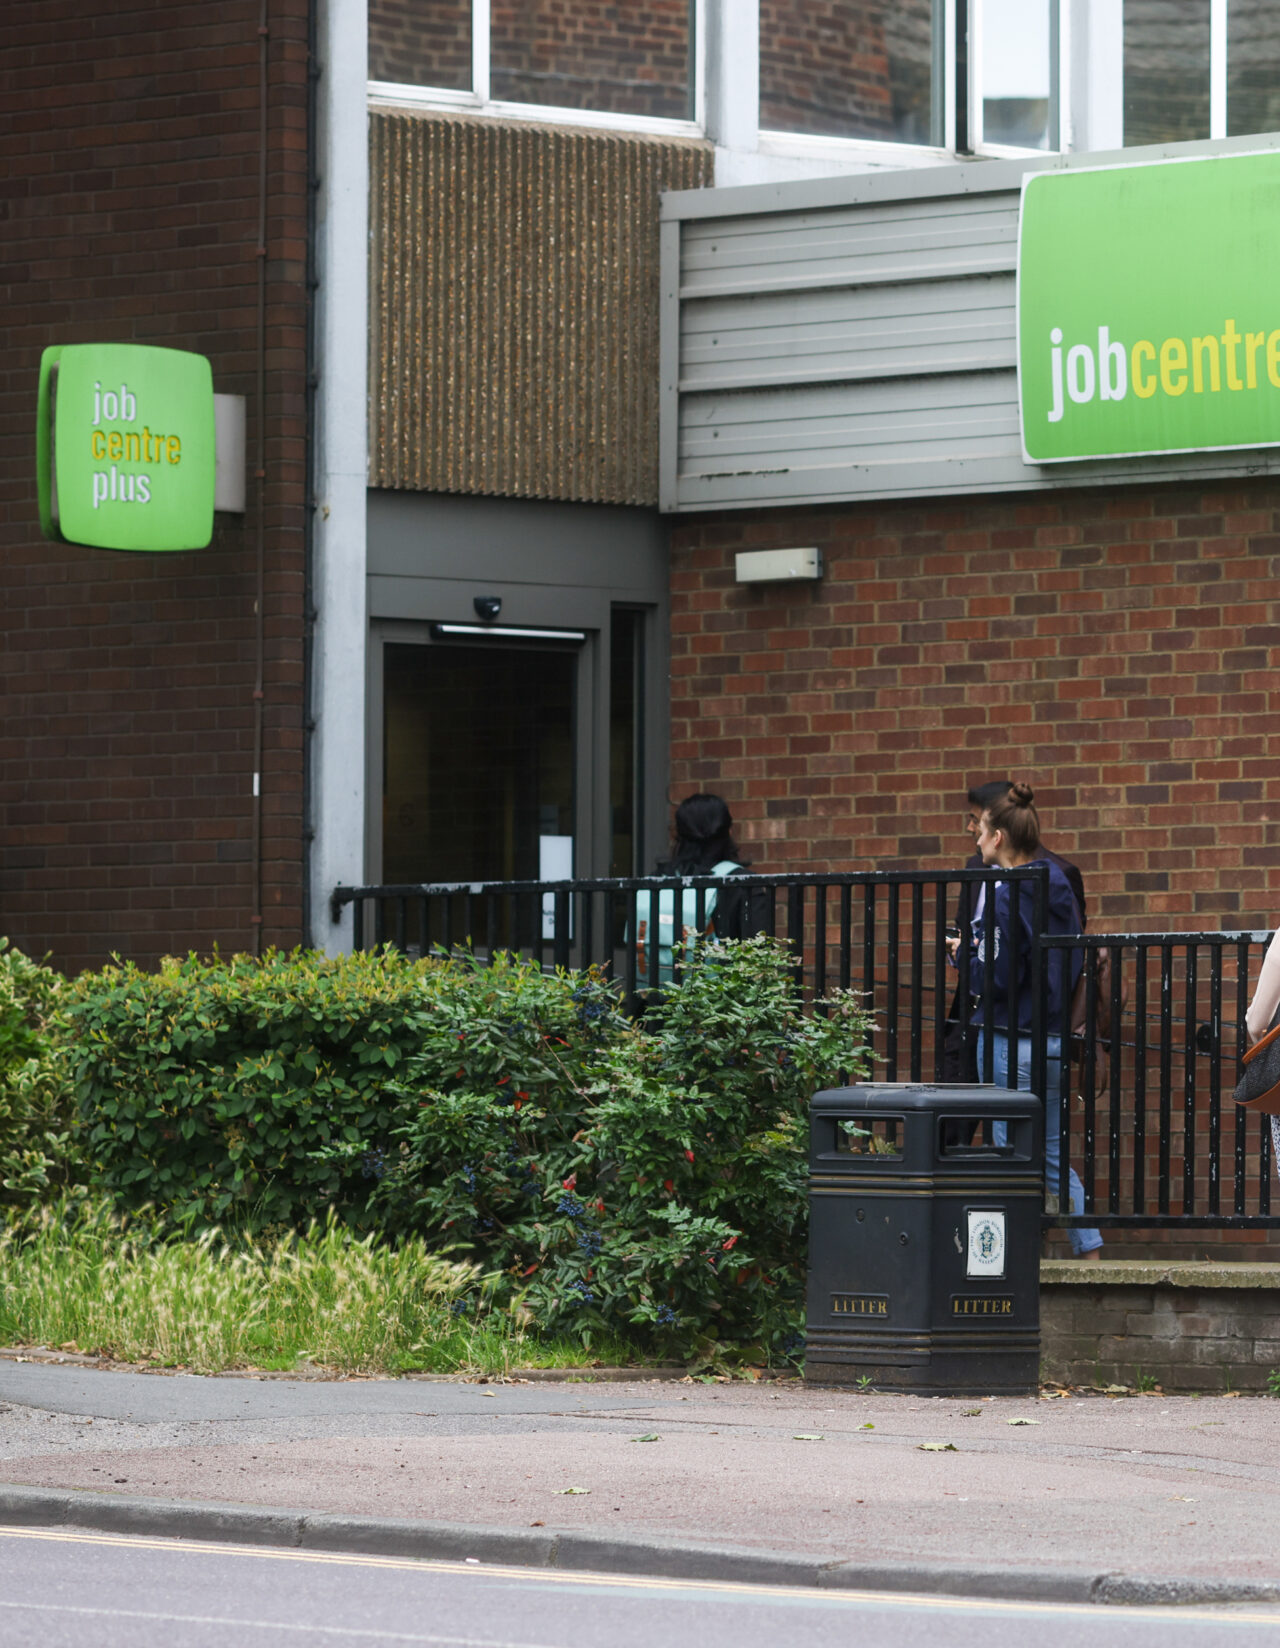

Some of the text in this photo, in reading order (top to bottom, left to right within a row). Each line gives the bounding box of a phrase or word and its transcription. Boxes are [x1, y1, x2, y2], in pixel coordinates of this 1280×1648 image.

[91, 381, 137, 426] job
[91, 426, 182, 465] centre
[92, 465, 152, 509] plus
[833, 1298, 888, 1314] LITTER
[953, 1299, 1012, 1314] LITTER
